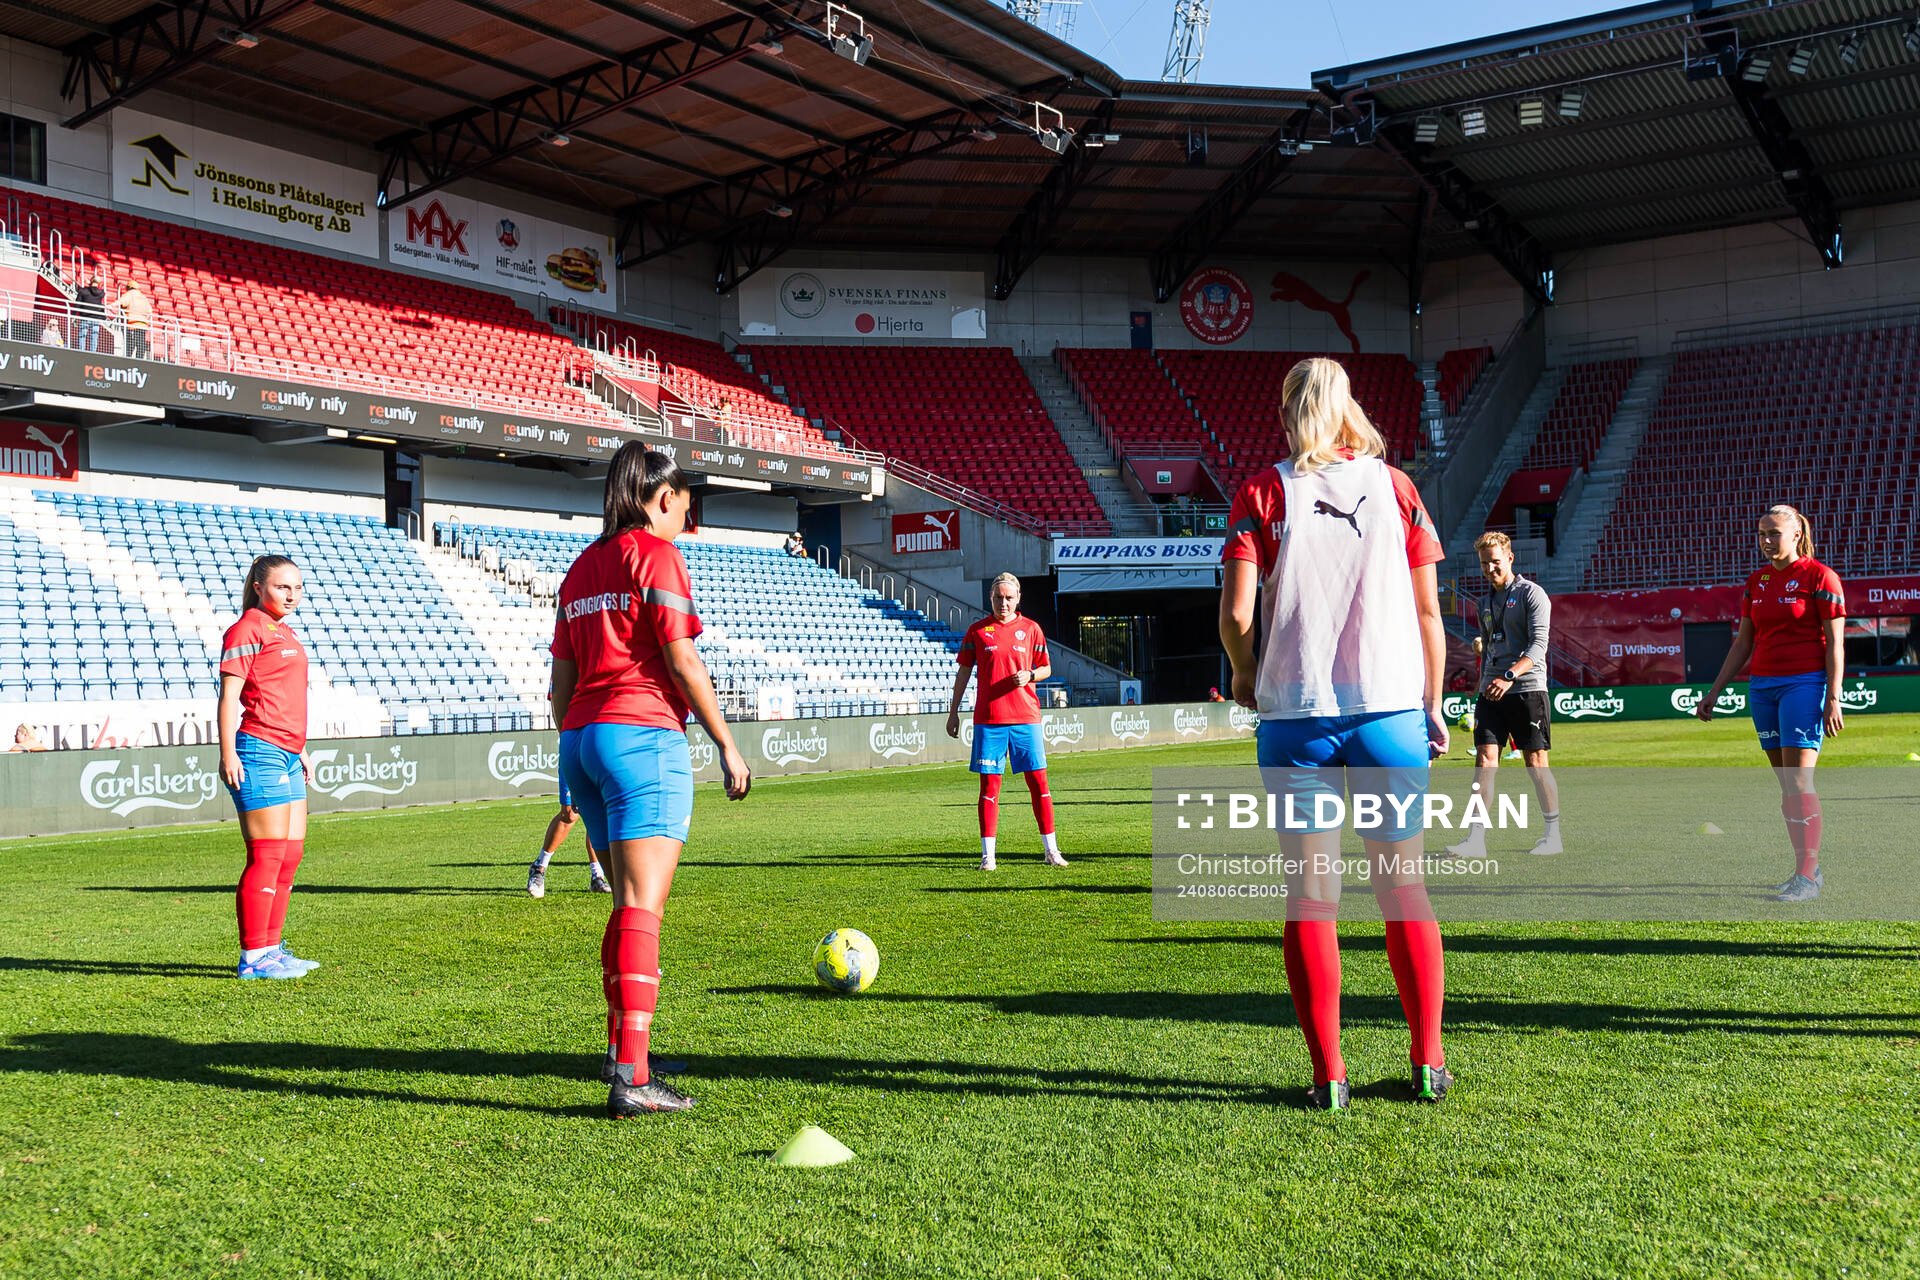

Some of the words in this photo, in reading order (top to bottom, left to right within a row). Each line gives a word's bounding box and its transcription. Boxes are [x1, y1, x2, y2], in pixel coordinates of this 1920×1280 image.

[194, 162, 276, 195] Jönssons
[279, 182, 365, 217] Plåtslageri
[212, 187, 219, 203] i
[222, 189, 324, 232] Helsingborg
[327, 217, 351, 233] AB
[405, 198, 470, 257] MAX
[393, 243, 432, 259] Södergatan
[454, 257, 480, 271] Hyllinge
[496, 255, 537, 276] HIF-målet
[828, 287, 892, 298] SVENSKA
[896, 289, 947, 299] FINANS
[878, 316, 923, 336] Hjerta
[20, 354, 55, 376] nify
[84, 364, 148, 388] reunify
[85, 380, 111, 389] GROUP
[178, 377, 236, 401] reunify
[179, 392, 203, 401] GROUP
[260, 388, 314, 410] reunify
[262, 403, 284, 412] GROUP
[320, 396, 348, 415] nify
[369, 403, 417, 425] reunify
[440, 413, 485, 434] reunify
[503, 422, 544, 442] reunify
[549, 427, 571, 445] nify
[0, 447, 53, 476] UMA
[691, 449, 724, 466] reunify
[727, 450, 745, 468] nify
[757, 457, 788, 474] reunify
[802, 463, 831, 479] reunify
[842, 469, 869, 484] reunify
[896, 530, 942, 553] PUMA
[1058, 544, 1158, 559] KLIPPANS
[1161, 544, 1213, 558] BUSS
[620, 593, 631, 611] IF
[1624, 643, 1681, 657] Wihlborgs
[1443, 696, 1477, 718] Carls
[1554, 692, 1624, 717] Carlsberg
[1671, 688, 1746, 713] Carlerg
[1041, 714, 1084, 742] Carlsberg
[1111, 711, 1151, 739] Carlsberg
[1173, 708, 1208, 734] Carlsberg
[762, 726, 828, 764] Carlsberg
[869, 721, 926, 755] Carlsberg
[307, 747, 417, 796] Carlsberg
[488, 740, 559, 784] Carlsbe
[80, 757, 219, 813] Carlsberg
